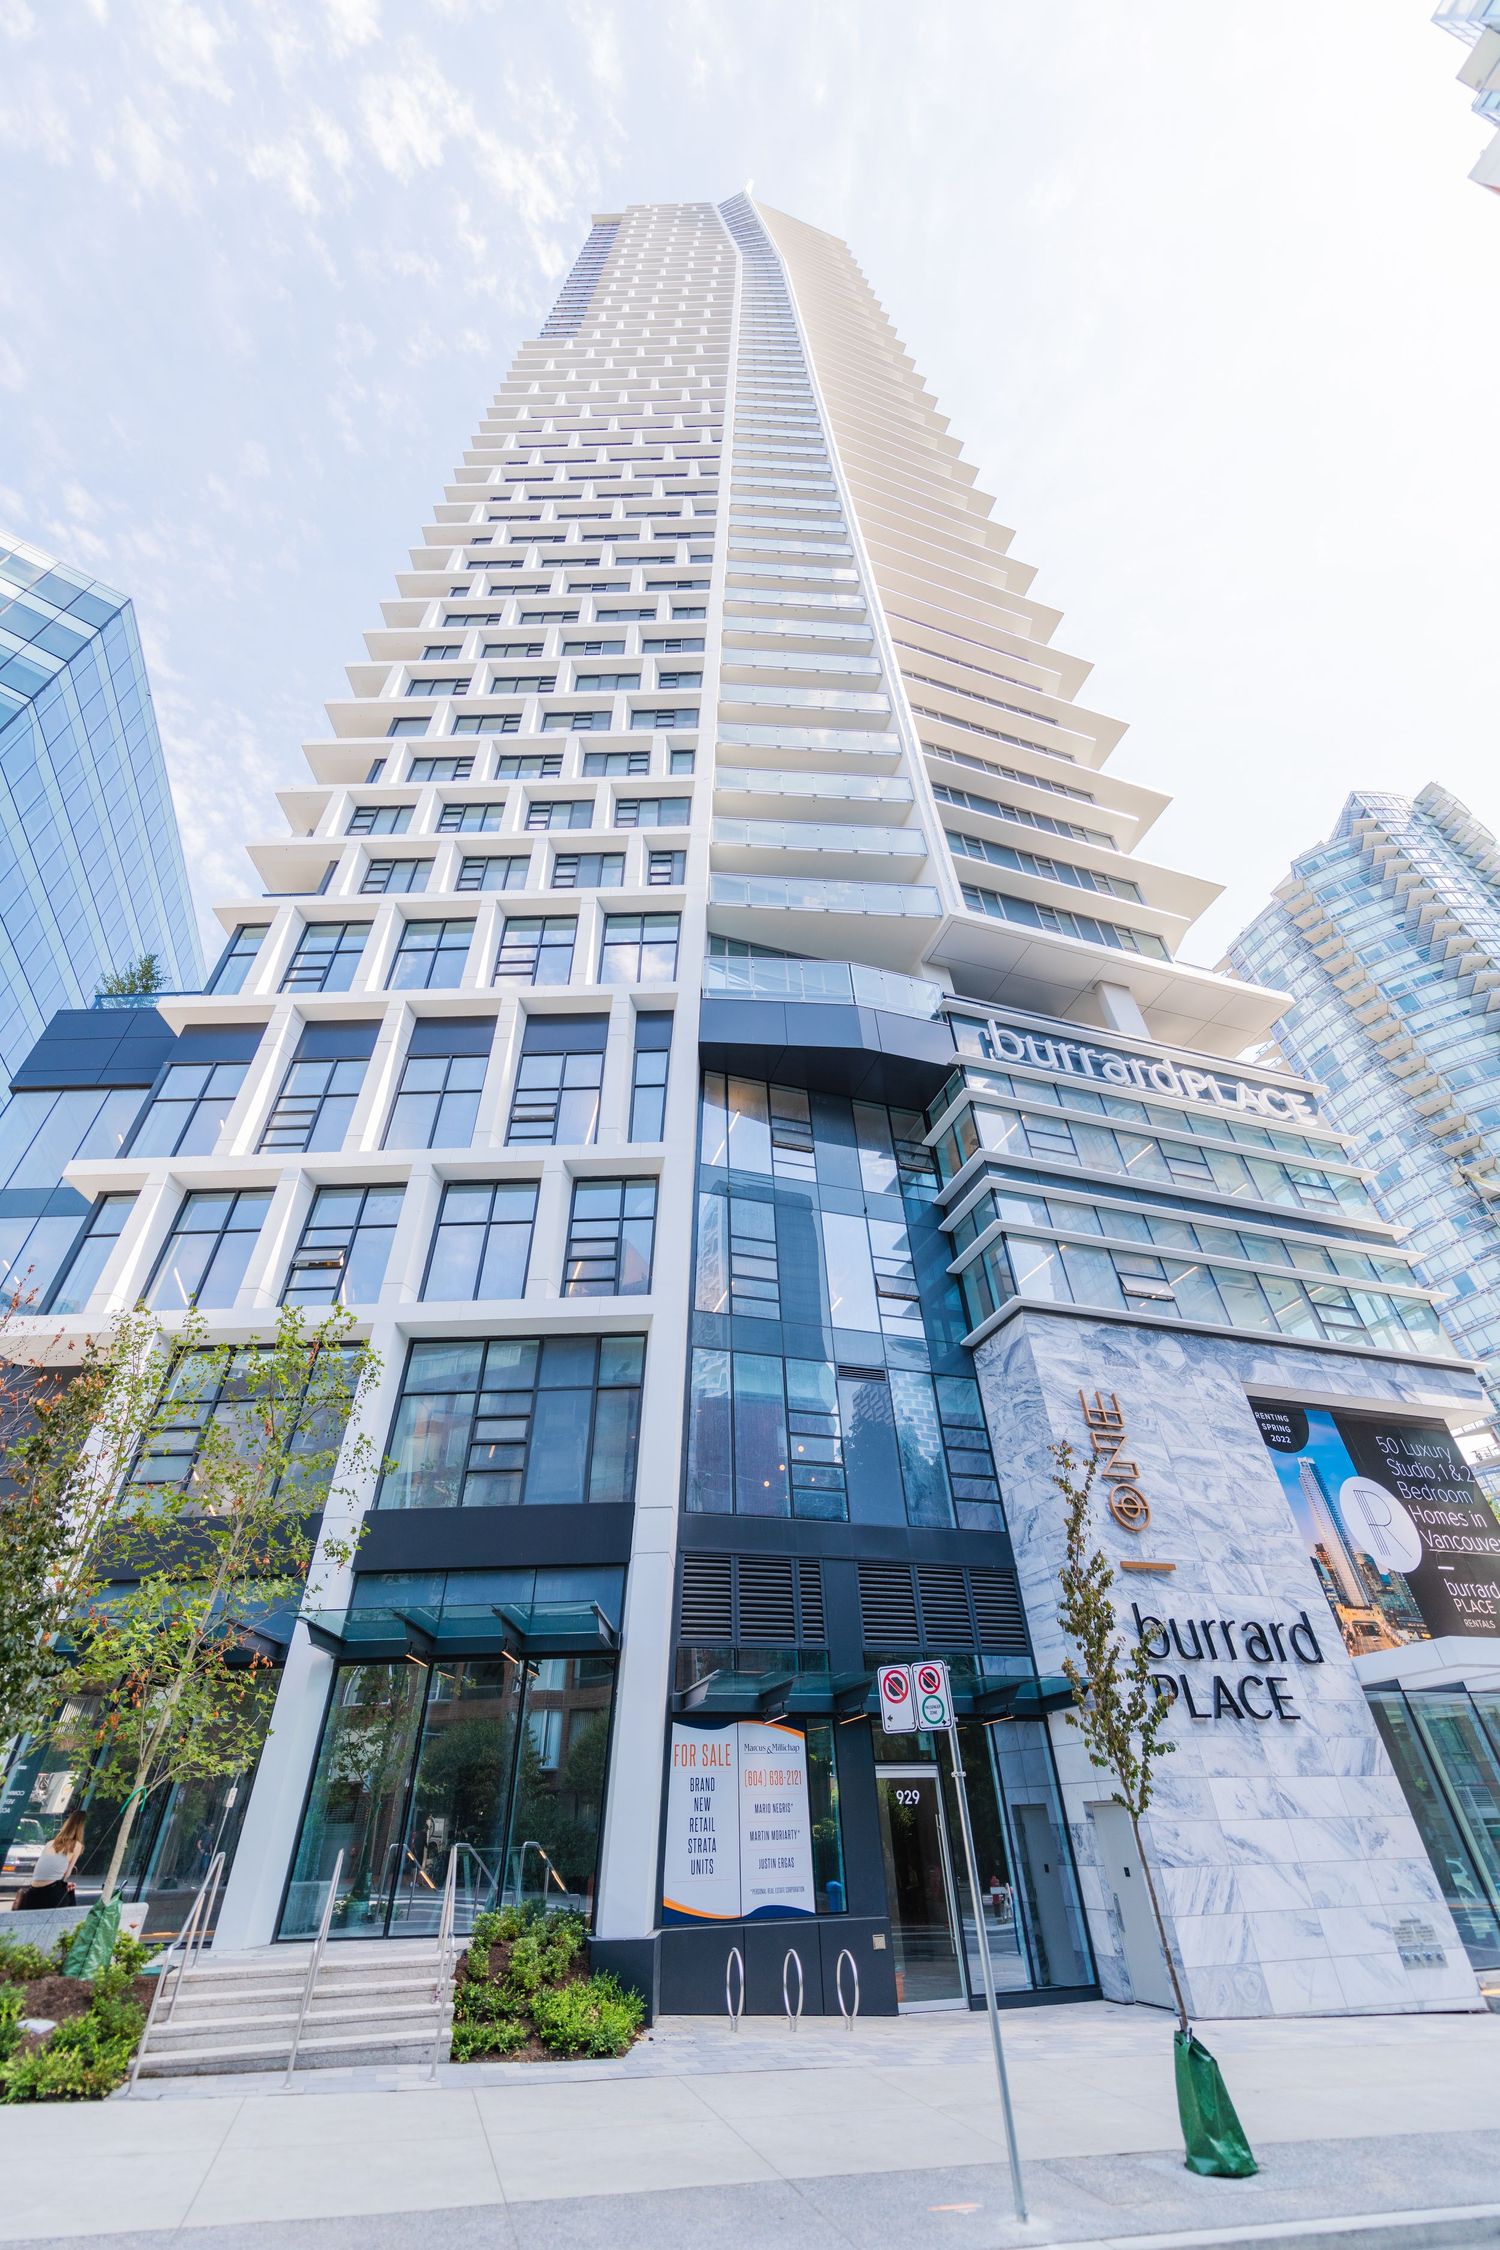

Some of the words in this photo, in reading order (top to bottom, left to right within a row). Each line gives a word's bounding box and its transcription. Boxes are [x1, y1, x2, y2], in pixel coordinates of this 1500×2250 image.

[1254, 1412, 1289, 1423] RENTING
[1261, 1423, 1292, 1433] SPRING
[1270, 1434, 1292, 1444] 2022
[1375, 1436, 1399, 1454] 50
[1400, 1438, 1452, 1463] Luxury
[1449, 1464, 1464, 1482] &
[1460, 1465, 1476, 1483] 2
[1396, 1480, 1474, 1504] Bedroom
[1408, 1504, 1469, 1527] Homes
[1468, 1510, 1488, 1528] in
[1419, 1530, 1500, 1552] Vancouve
[1443, 1578, 1500, 1599] burrard
[1453, 1598, 1497, 1614] PLACE
[1463, 1618, 1496, 1629] RENTALS
[1131, 1602, 1325, 1664] burrard
[1148, 1673, 1301, 1720] PLACE
[674, 1743, 697, 1767] FOR
[702, 1743, 731, 1767] SALE
[744, 1743, 766, 1752] Marcus
[772, 1743, 800, 1752] Millichap
[690, 1777, 715, 1792] BRAND
[744, 1769, 767, 1787] (604)
[769, 1769, 802, 1786] 638-2121
[693, 1797, 711, 1812] NEW
[896, 1789, 920, 1805] 929
[754, 1803, 771, 1814] MARIO
[689, 1817, 715, 1833] RETAIL
[749, 1830, 770, 1841] MARTIN
[687, 1837, 717, 1854] STRATA
[690, 1858, 714, 1875] UNITS
[758, 1858, 777, 1870] JUSTIN
